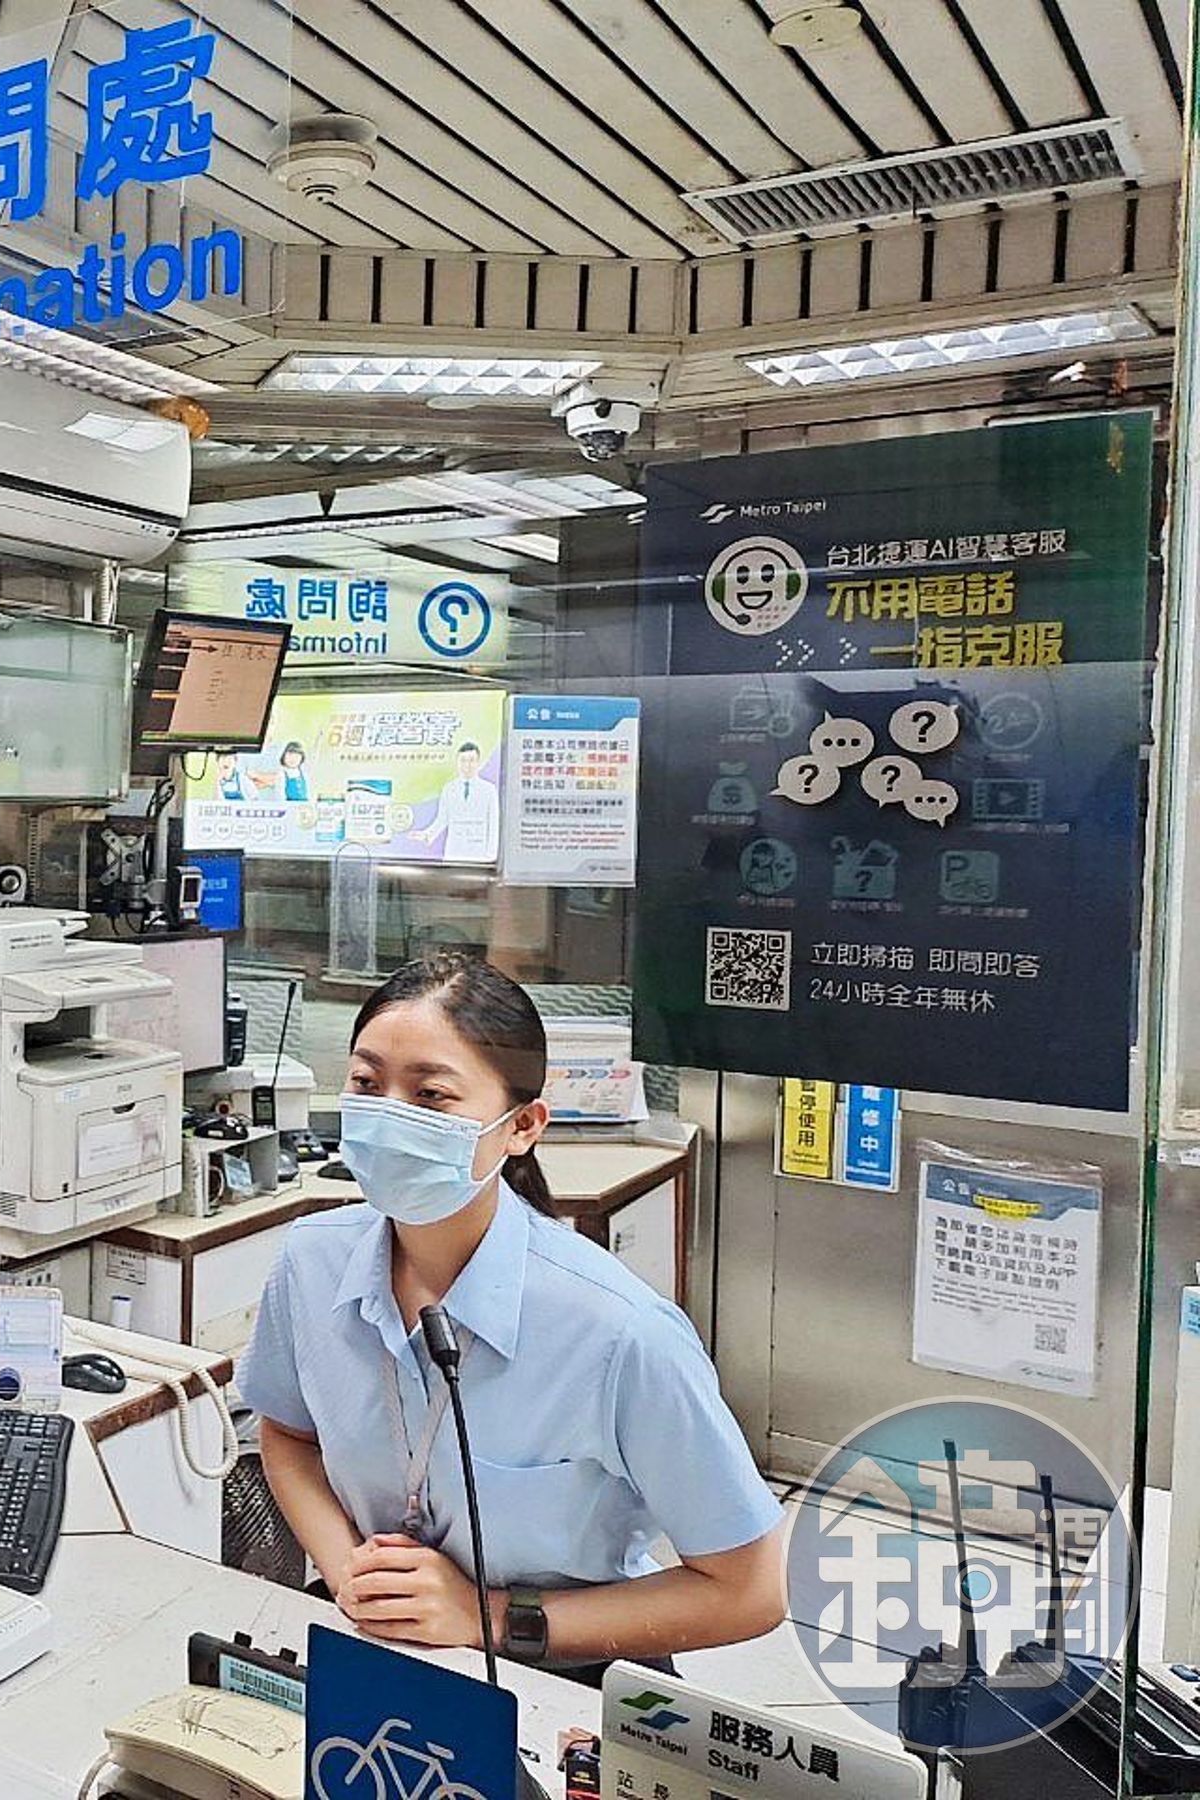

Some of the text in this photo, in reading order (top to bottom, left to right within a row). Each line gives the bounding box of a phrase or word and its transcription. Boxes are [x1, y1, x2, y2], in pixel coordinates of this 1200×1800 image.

[740, 500, 827, 518] Metro Taipei
[826, 529, 1066, 568] 台北捷運AI智慧客服
[826, 571, 1016, 622] 不用電話
[869, 621, 1065, 668] 一指克服
[810, 941, 1041, 979] 立即掃描 即問即答
[809, 978, 997, 1013] 24小時全年無休
[620, 1722, 688, 1757] Metro Taipei
[708, 1709, 841, 1784] 服務人員
[707, 1749, 760, 1783] Staff
